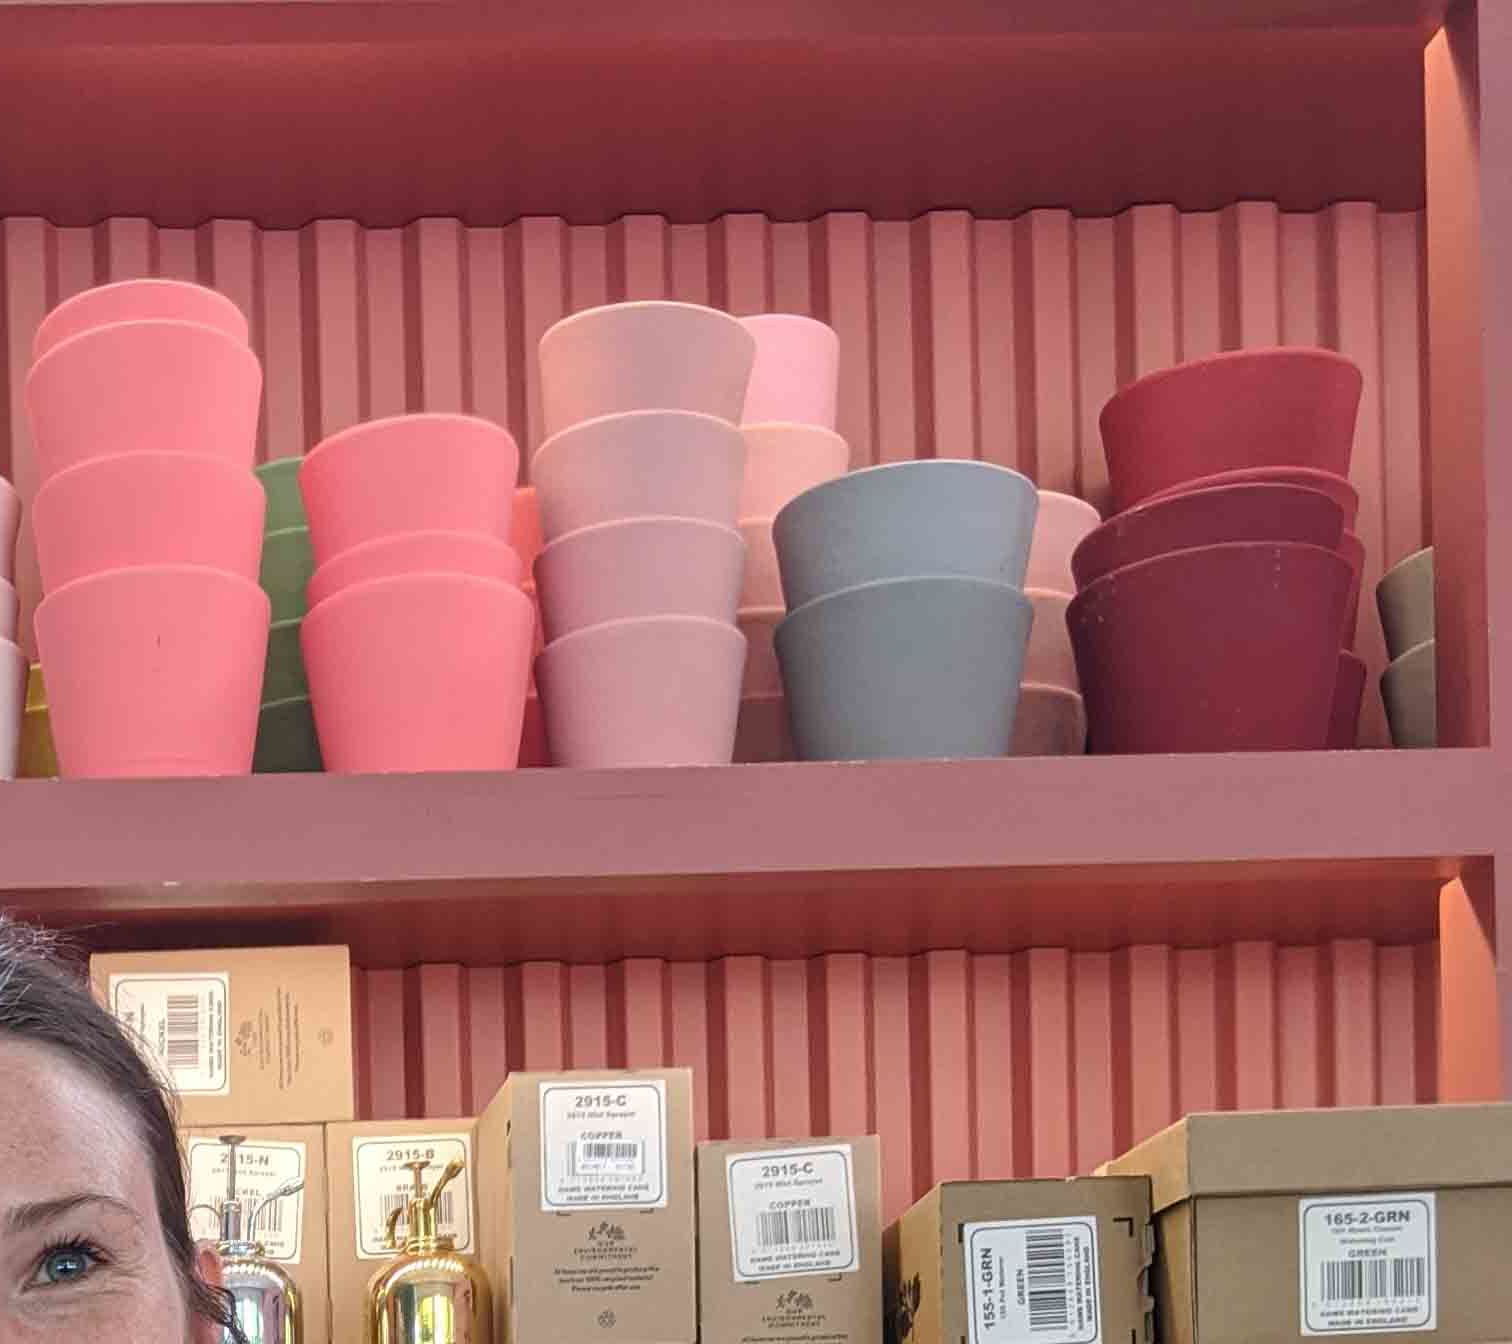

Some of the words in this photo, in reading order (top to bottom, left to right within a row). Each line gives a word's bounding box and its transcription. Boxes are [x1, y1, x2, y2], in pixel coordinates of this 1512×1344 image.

[575, 1095, 627, 1108] 2915-C
[218, 1153, 269, 1165] 215-N
[761, 1162, 814, 1178] 2915-C
[1325, 1210, 1411, 1226] 165-2-GRN
[980, 1247, 996, 1330] 155-1-GRN
